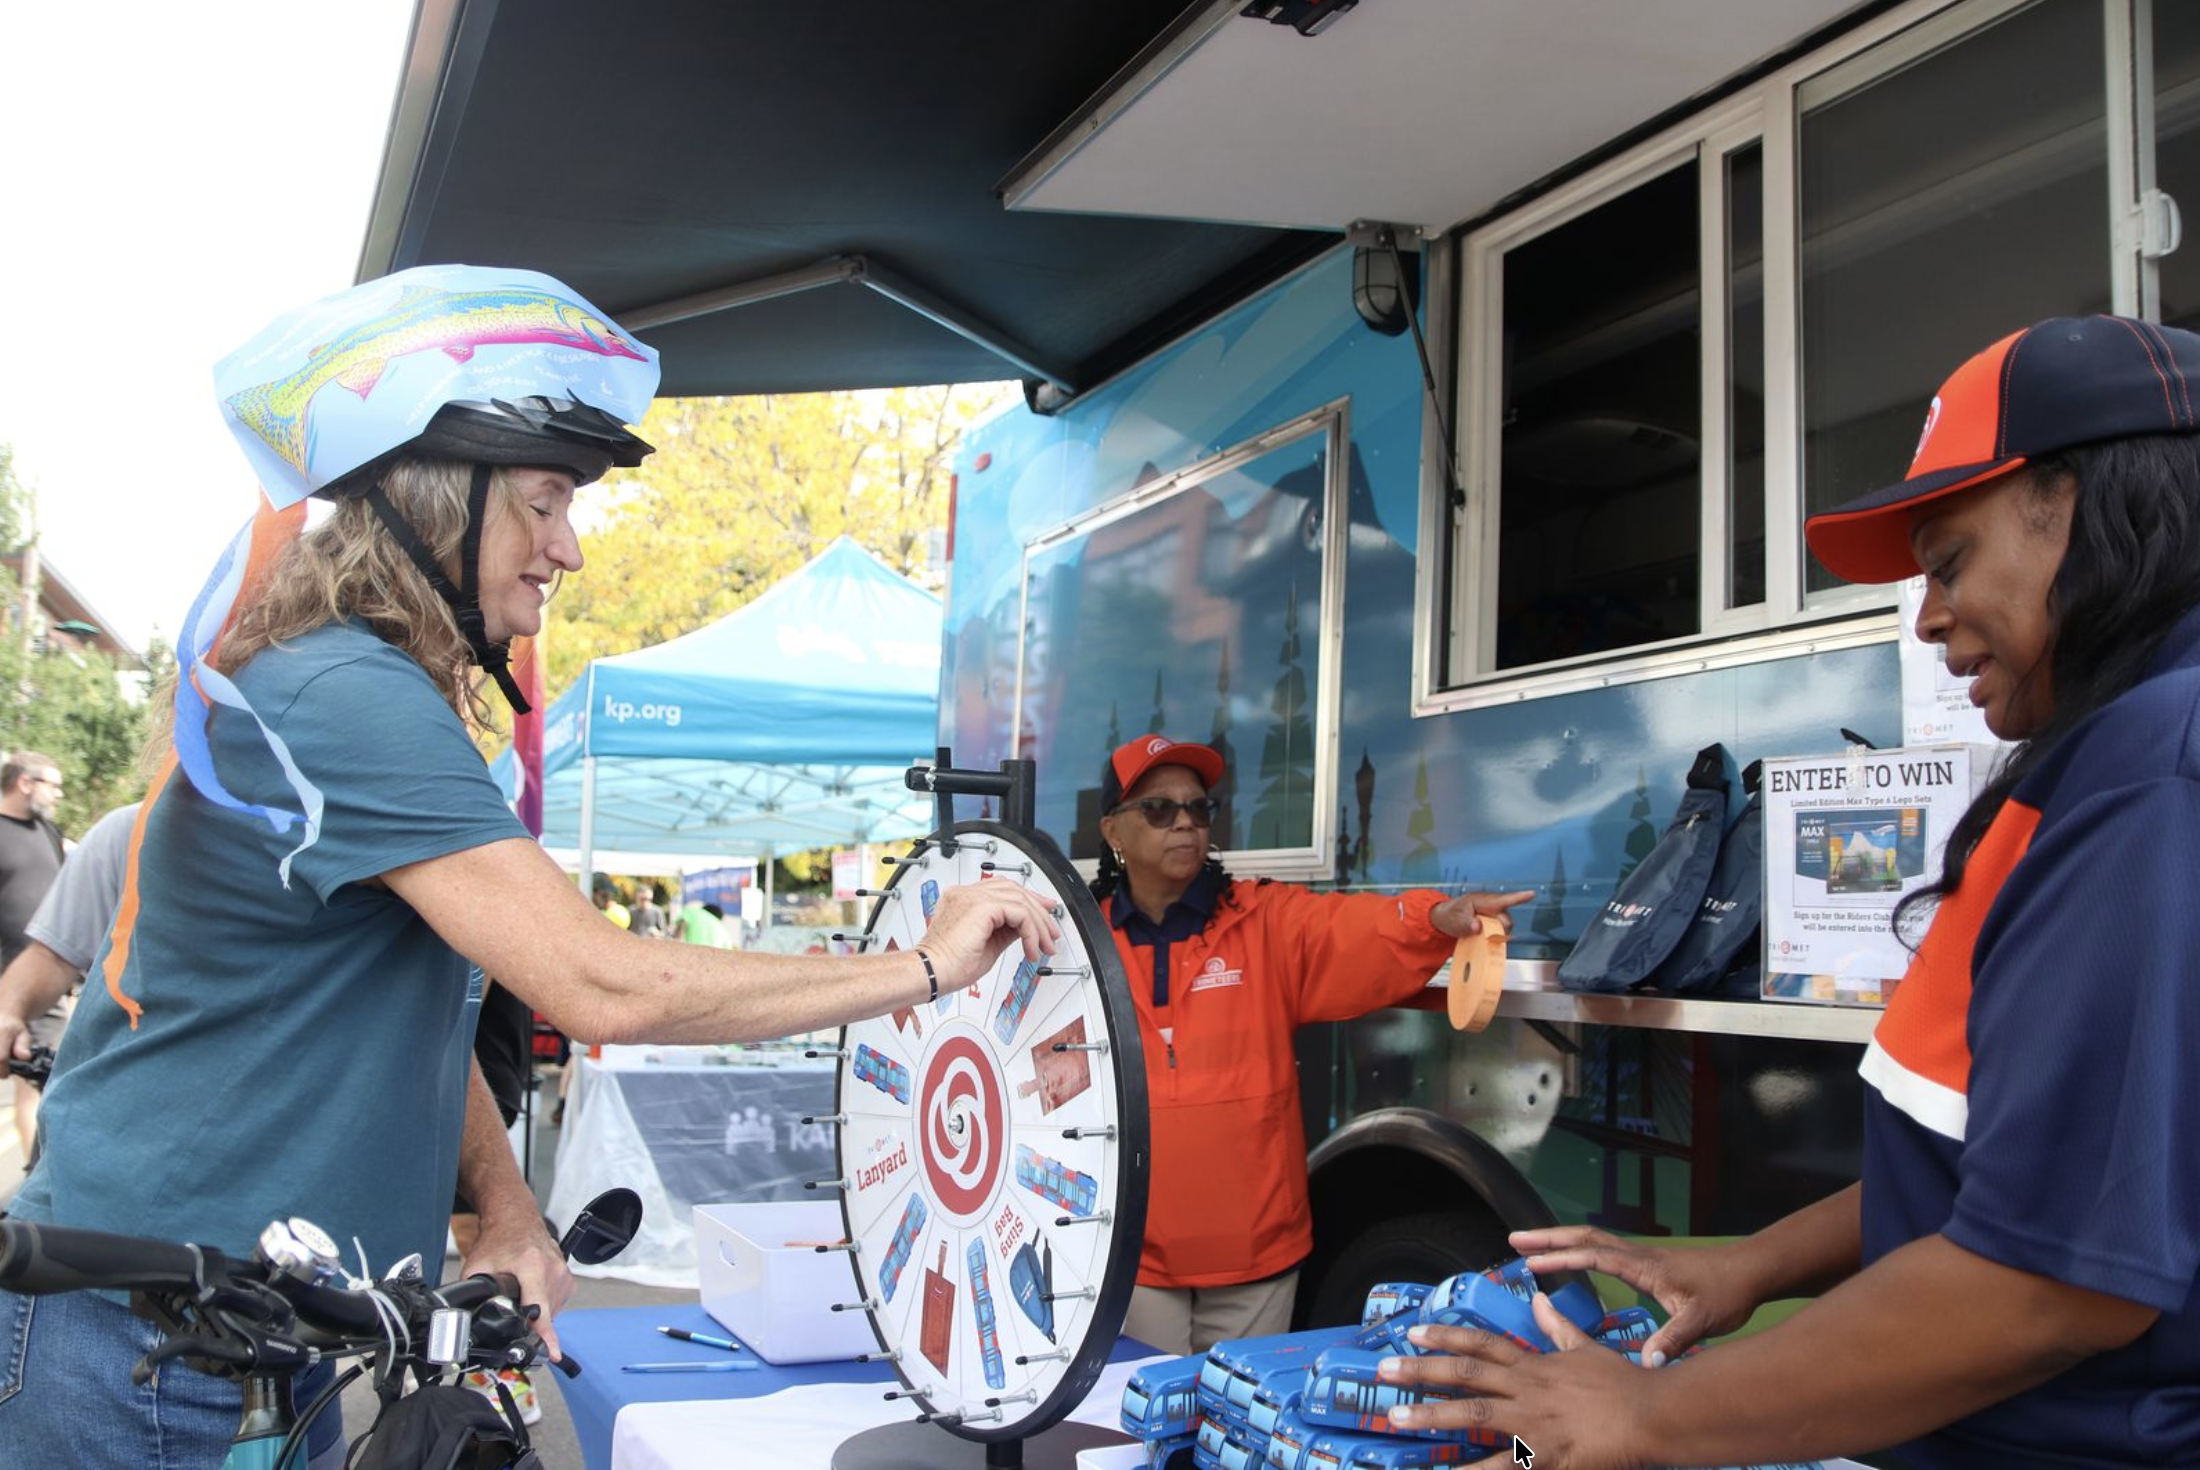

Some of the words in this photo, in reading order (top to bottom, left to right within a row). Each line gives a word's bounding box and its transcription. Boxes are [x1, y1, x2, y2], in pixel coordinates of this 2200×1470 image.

[605, 694, 681, 726] kp.org
[1771, 768, 1848, 792] ENTER
[1863, 764, 1891, 788] TO
[1898, 761, 1953, 787] WIN
[1791, 799, 1817, 807] Limited
[1819, 798, 1844, 806] Edition
[1846, 797, 1862, 805] Max
[1865, 796, 1884, 805] Type
[1800, 826, 1824, 837] MAX
[857, 1141, 907, 1191] Lanyard
[994, 1203, 1014, 1239] Bag
[1000, 1216, 1024, 1259] Sling
